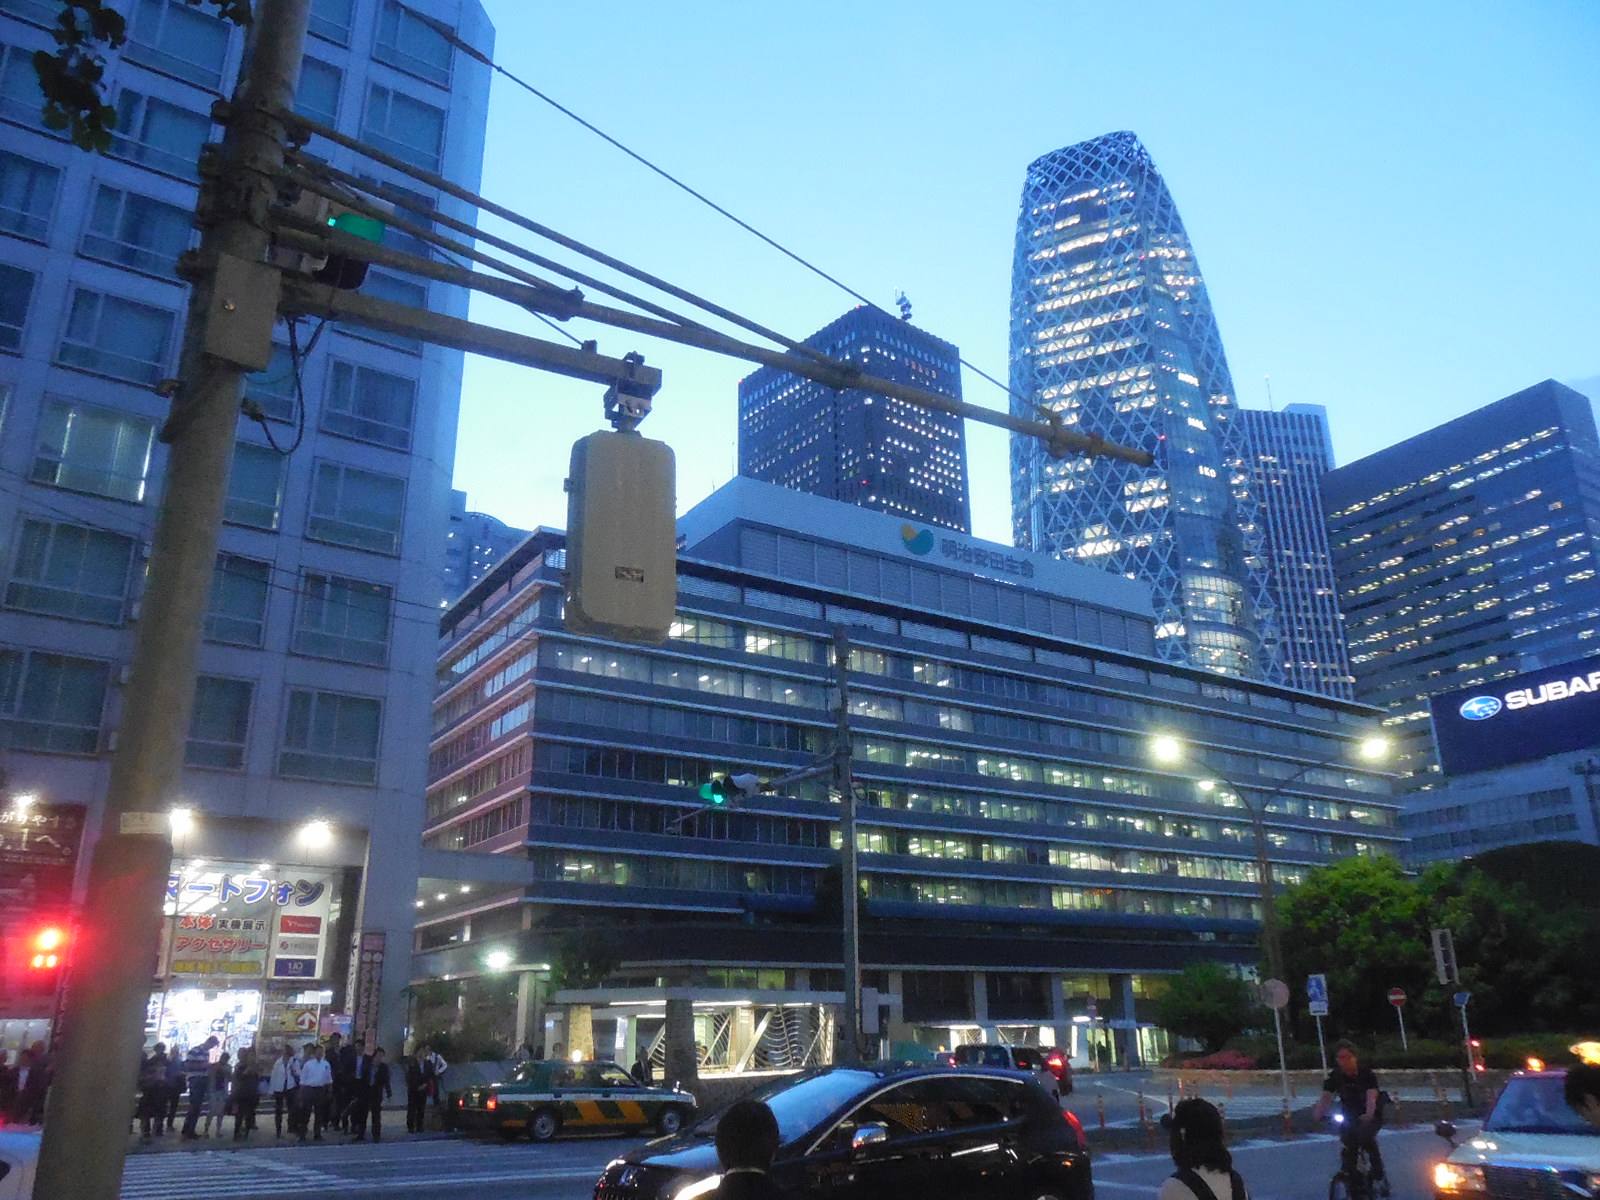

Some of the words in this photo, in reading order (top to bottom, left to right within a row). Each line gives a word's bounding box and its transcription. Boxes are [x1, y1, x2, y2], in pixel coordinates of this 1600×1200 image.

[941, 538, 1034, 578] 明治安田生命
[179, 914, 214, 931] 本体
[176, 936, 266, 953] アクセサリー
